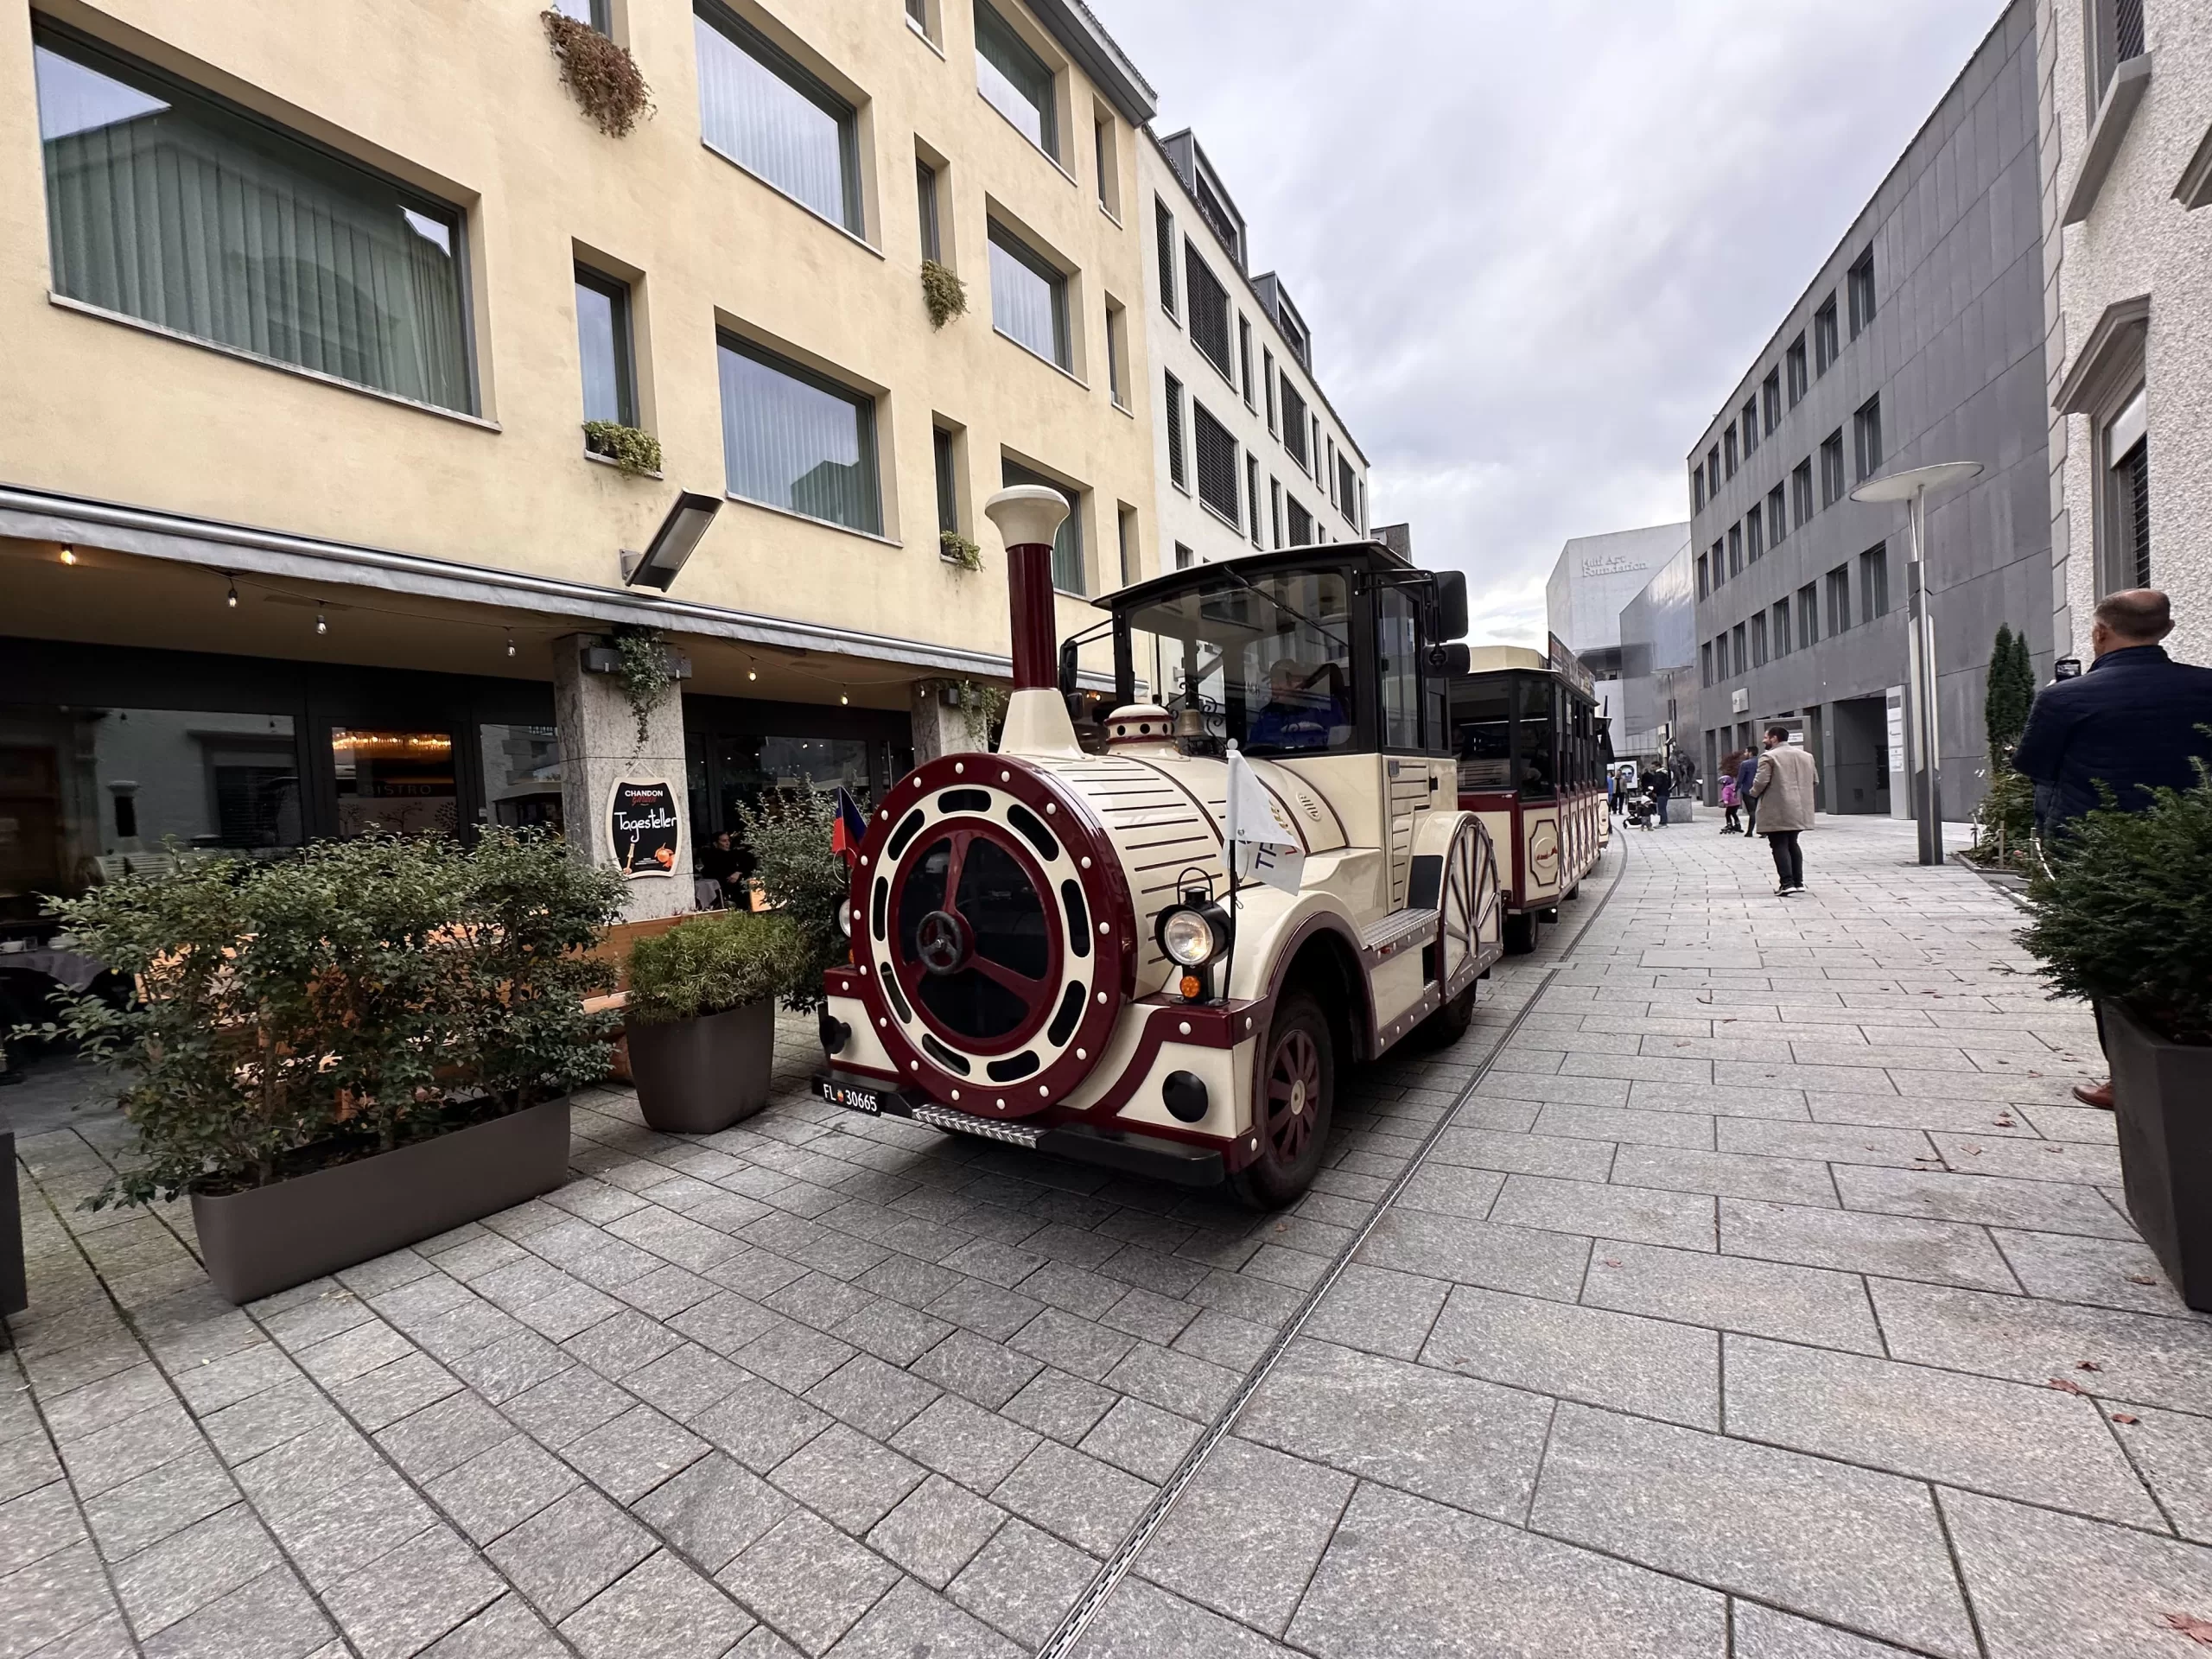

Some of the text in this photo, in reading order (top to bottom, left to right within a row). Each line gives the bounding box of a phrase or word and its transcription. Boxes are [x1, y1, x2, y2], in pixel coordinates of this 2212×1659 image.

[1582, 563, 1648, 577] Foundation
[365, 785, 431, 795] BISTRO
[613, 807, 677, 843] Tagesteller
[823, 1084, 878, 1112] FL 30665
